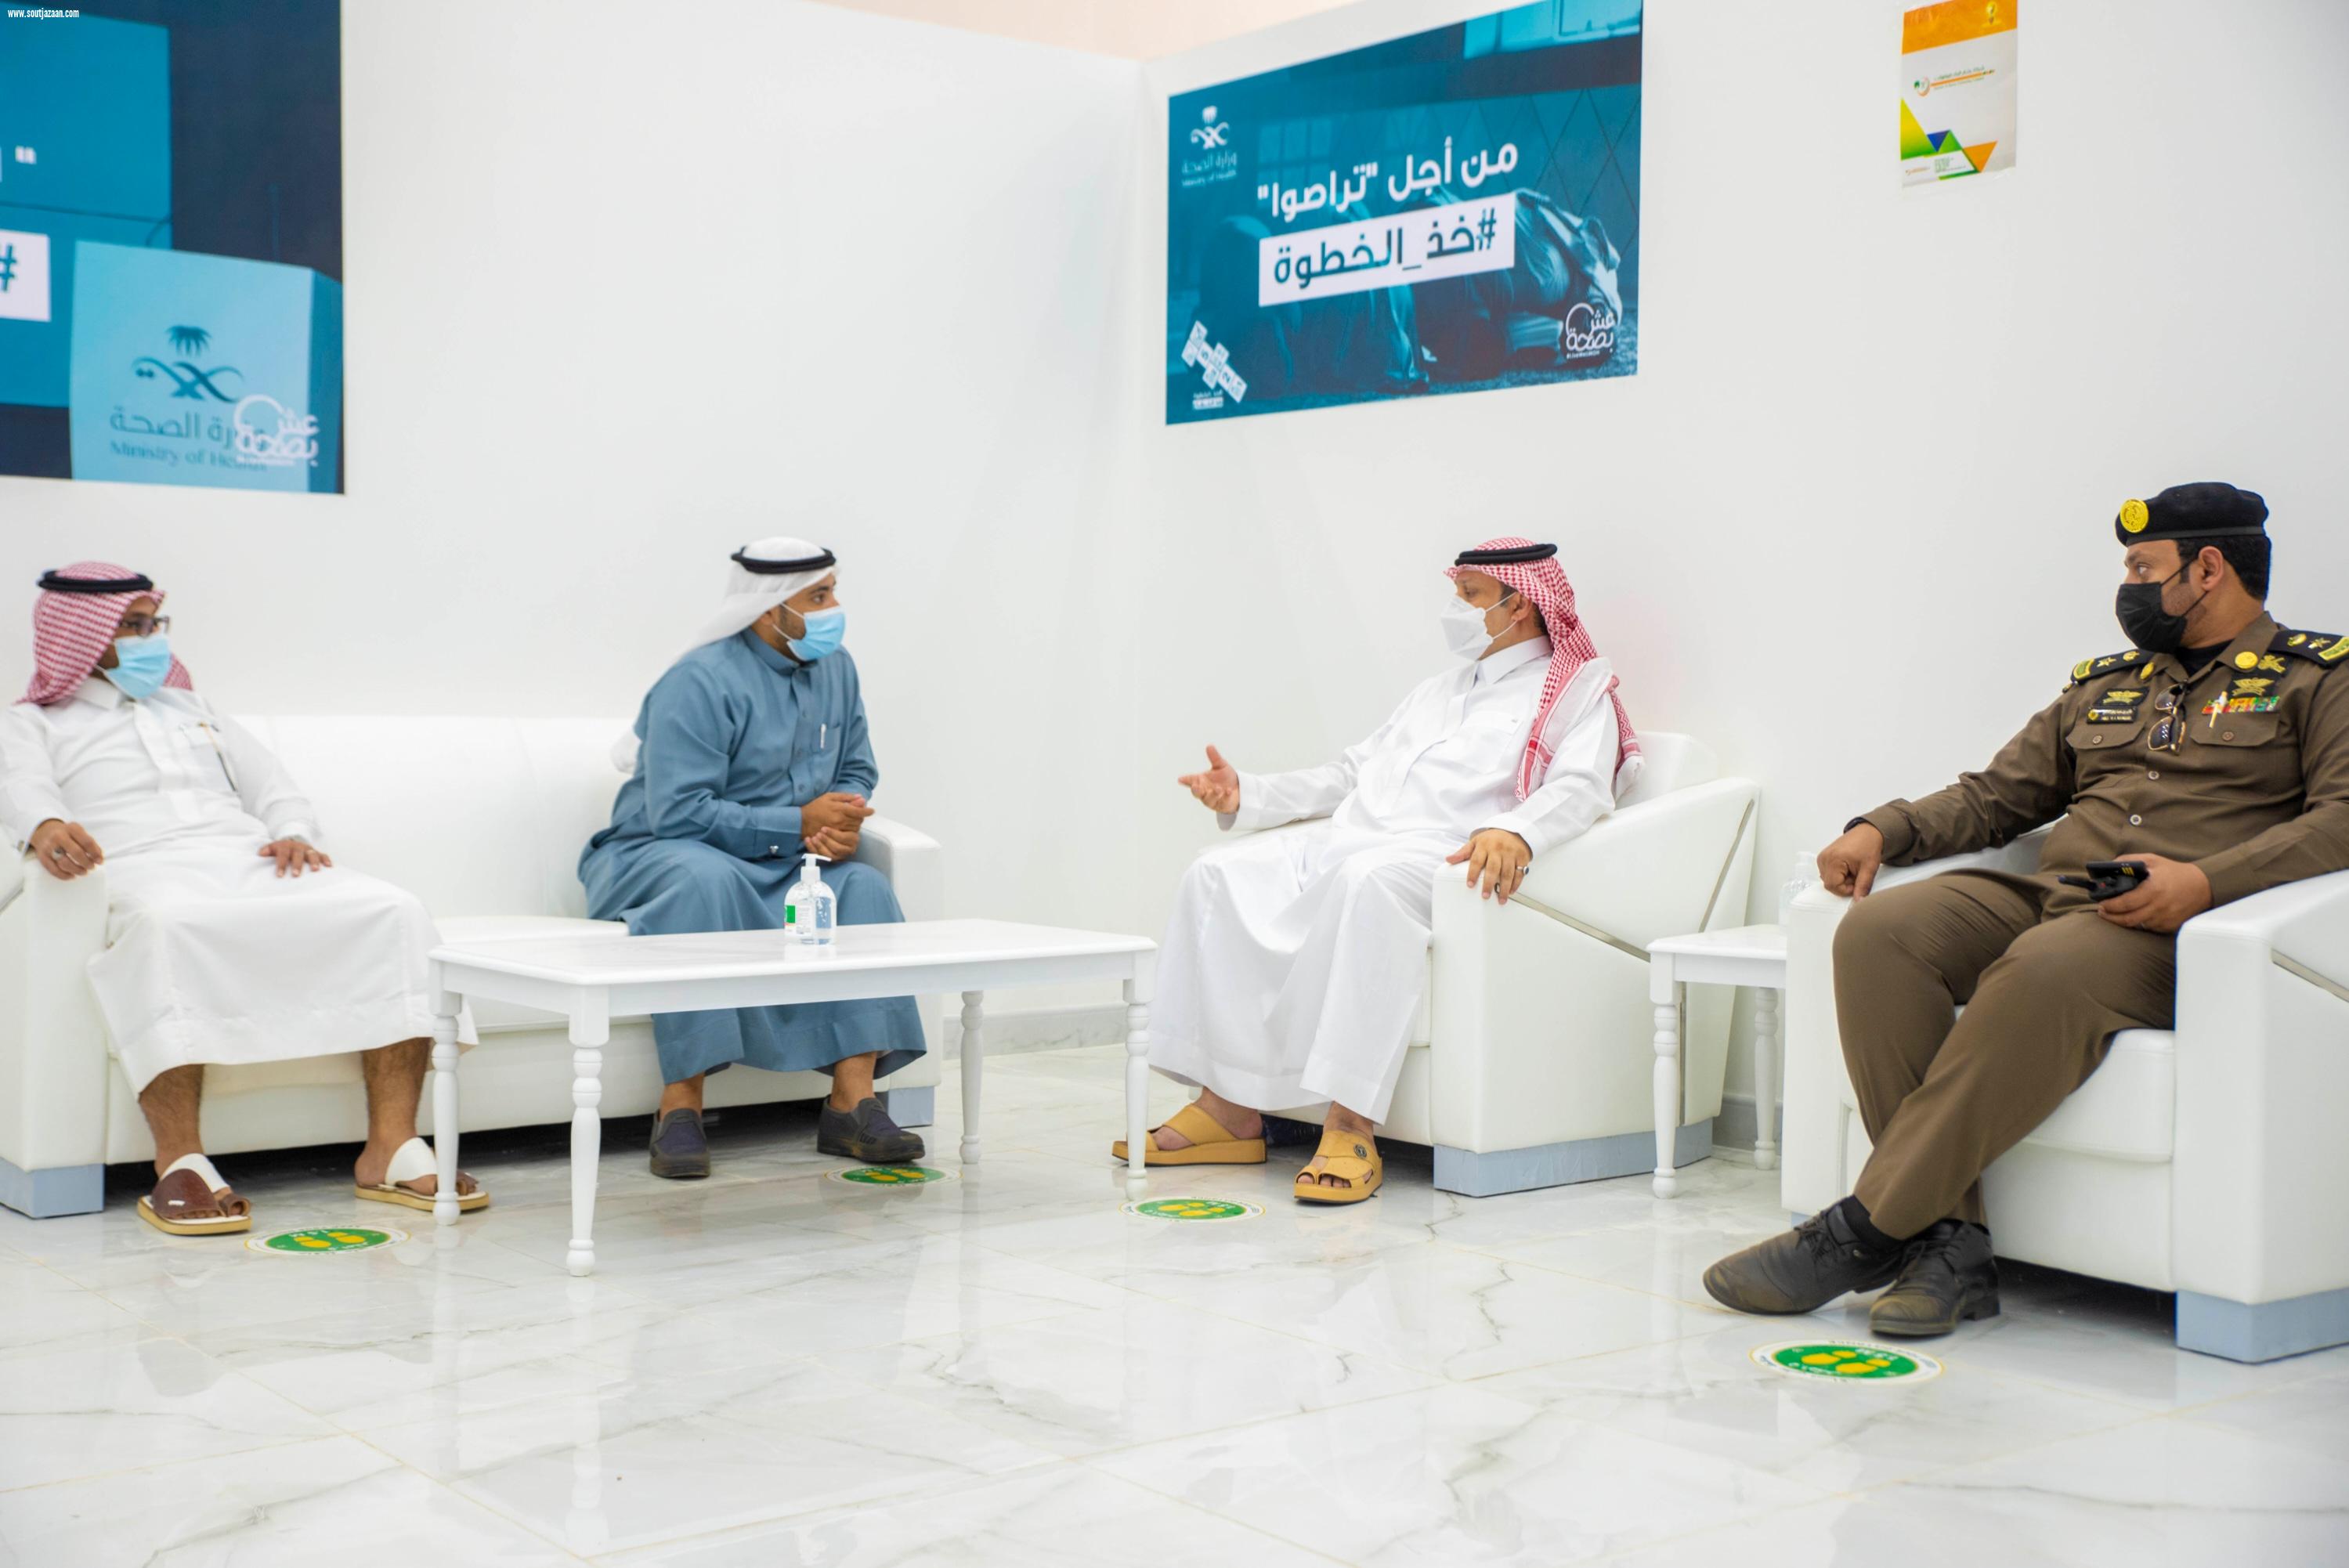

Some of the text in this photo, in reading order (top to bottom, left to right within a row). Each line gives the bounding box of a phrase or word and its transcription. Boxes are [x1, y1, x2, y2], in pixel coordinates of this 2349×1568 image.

[1257, 135, 1518, 223] من أجل "تراصوا"
[1274, 207, 1498, 290] #خذ_الخطوة
[110, 405, 201, 439] الصحة
